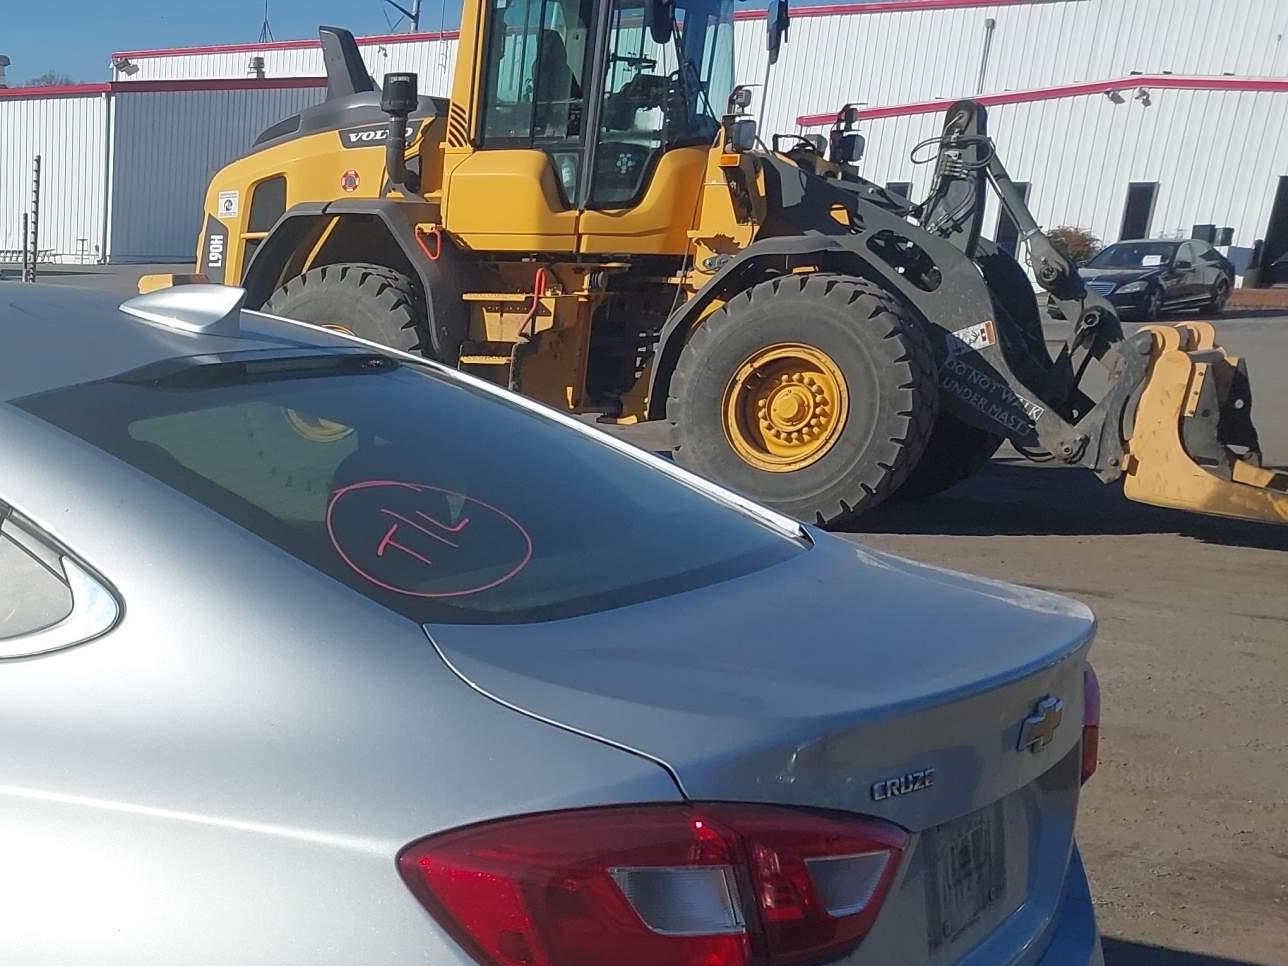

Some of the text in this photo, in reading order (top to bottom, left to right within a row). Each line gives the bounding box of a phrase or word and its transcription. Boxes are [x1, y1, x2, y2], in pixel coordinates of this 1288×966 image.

[349, 127, 413, 142] VOLO
[208, 234, 224, 268] L90H
[947, 359, 967, 376] DO
[968, 369, 997, 393] NOT
[943, 377, 1024, 432] UNDER MAST
[871, 768, 936, 801] CRUZE
